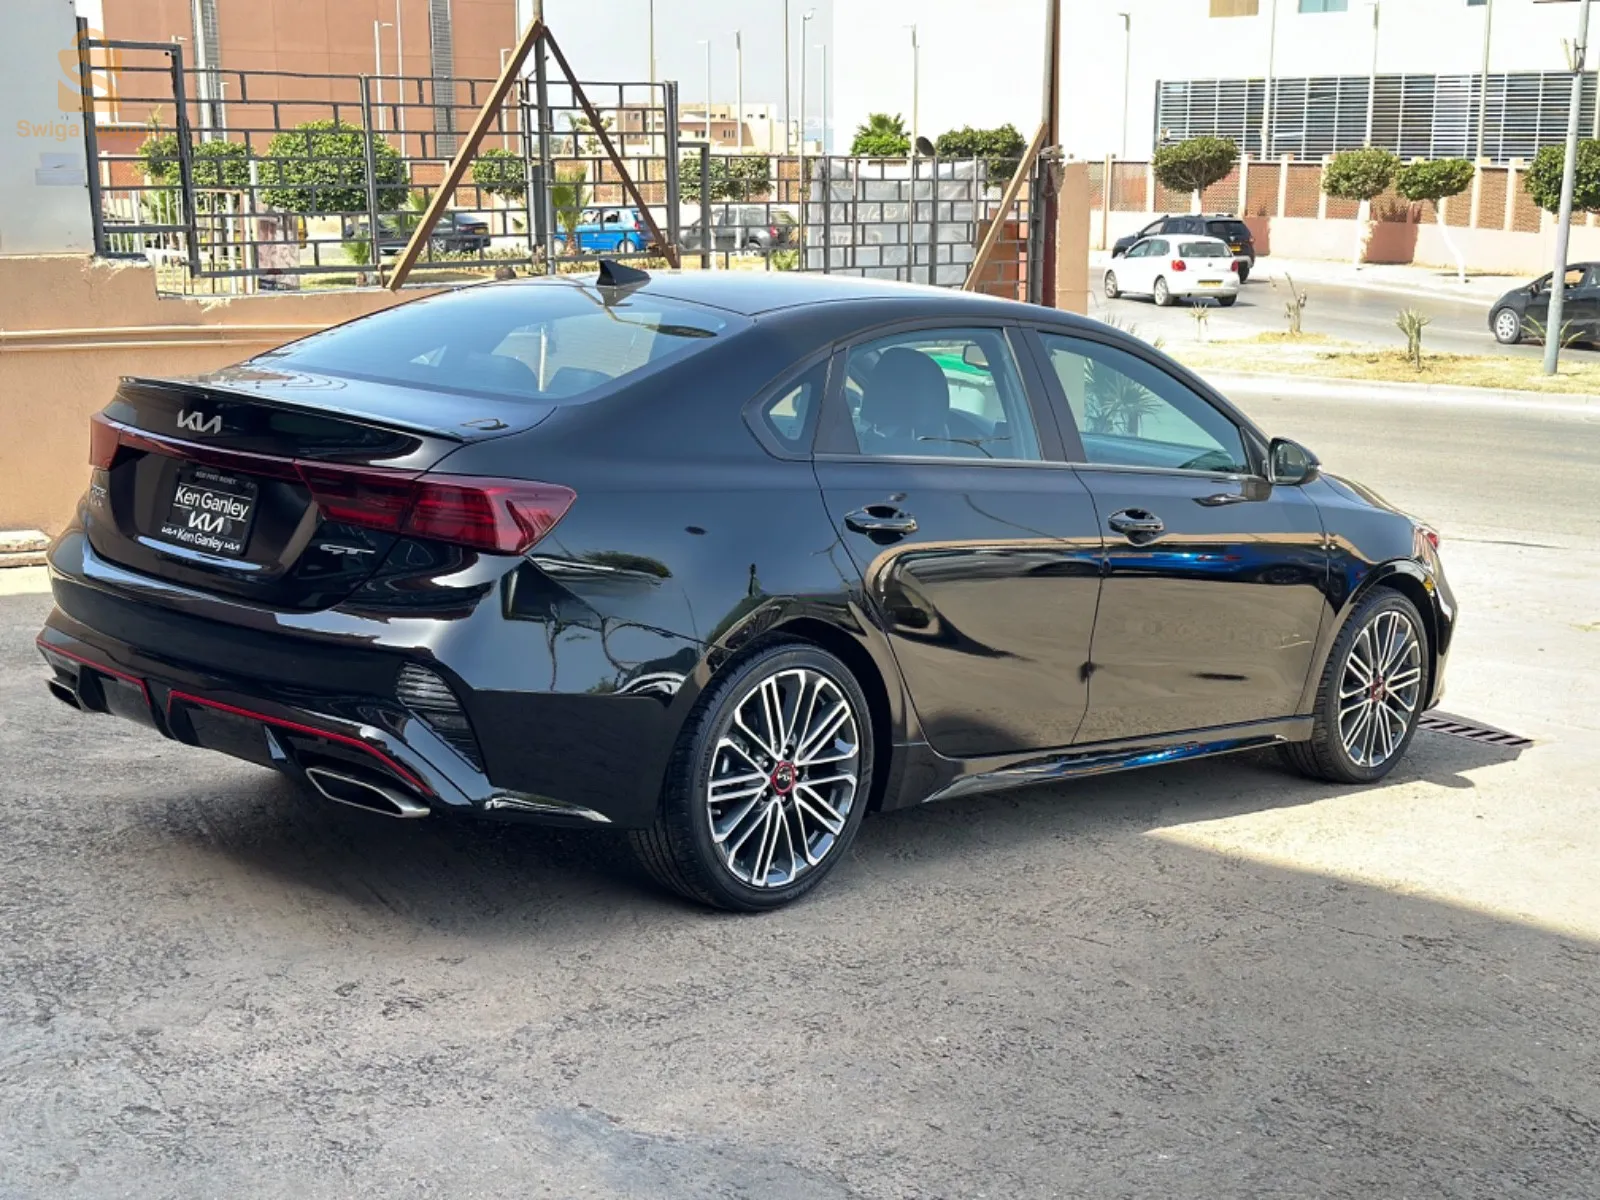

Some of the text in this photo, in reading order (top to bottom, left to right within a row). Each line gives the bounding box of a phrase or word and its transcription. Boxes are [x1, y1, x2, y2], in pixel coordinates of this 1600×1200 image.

[177, 408, 222, 434] KIA
[174, 485, 250, 519] Ken Ganley
[188, 510, 225, 533] KIA
[176, 528, 195, 544] Ken
[195, 533, 224, 552] Ganley
